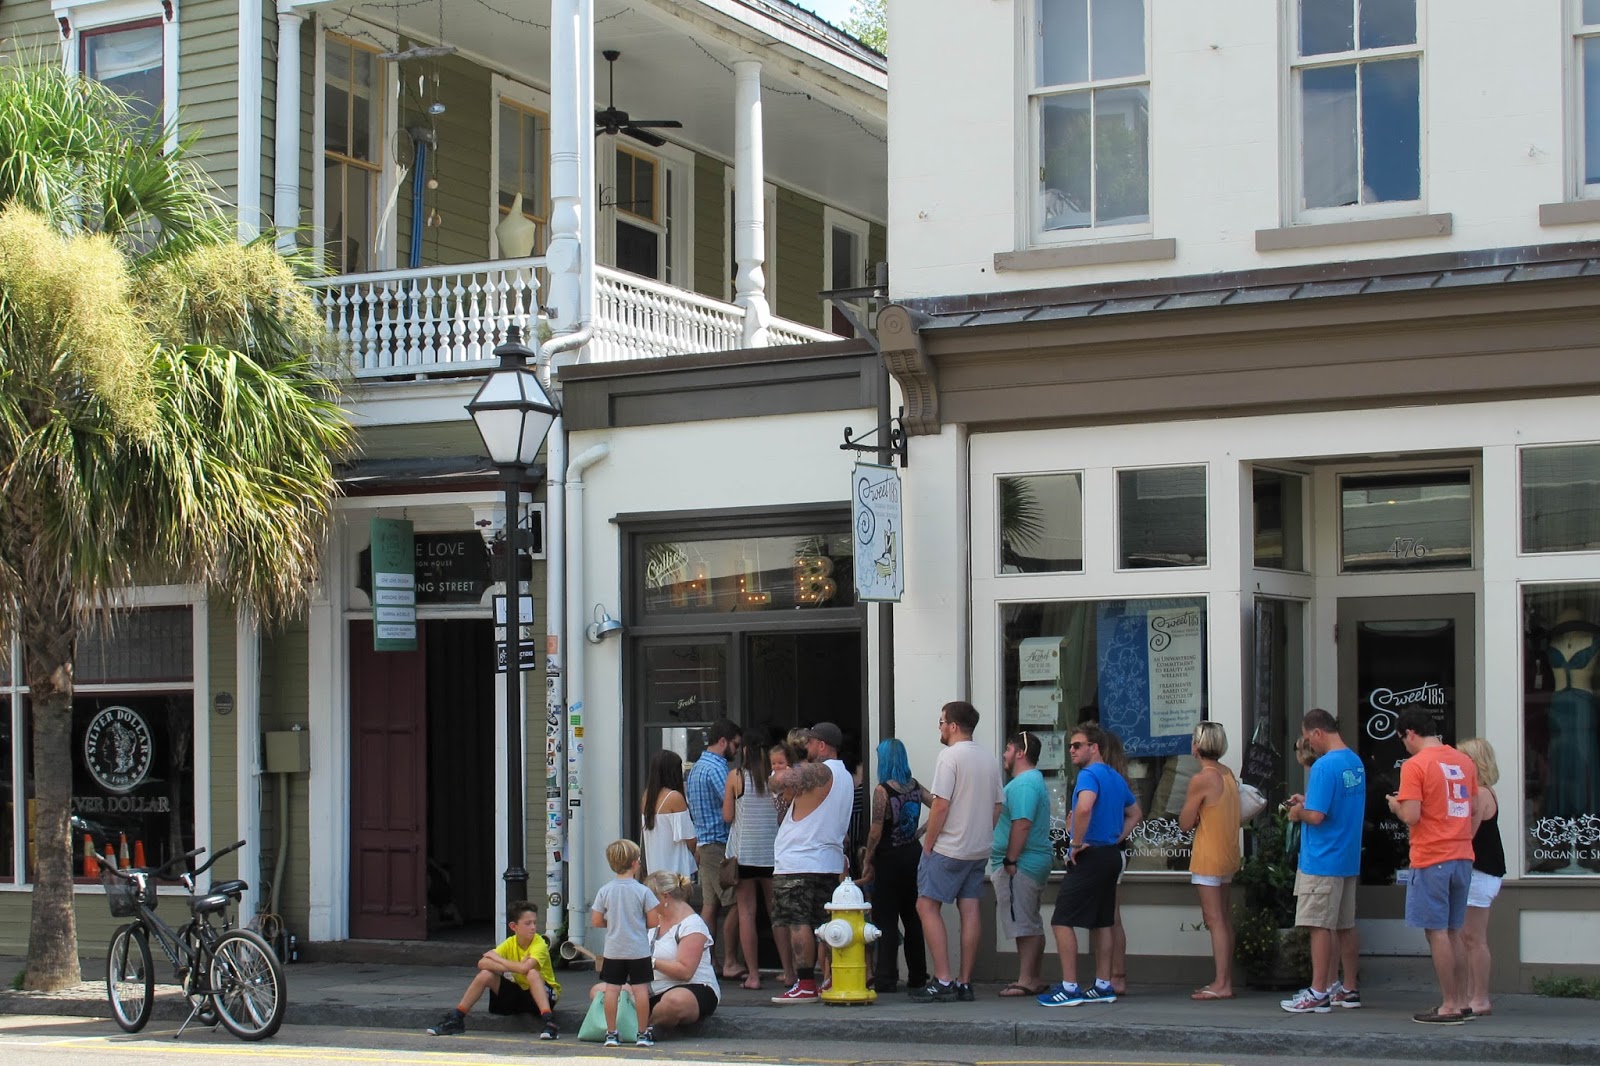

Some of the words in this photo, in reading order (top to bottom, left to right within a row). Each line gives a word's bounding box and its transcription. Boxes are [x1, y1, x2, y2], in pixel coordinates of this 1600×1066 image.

[857, 474, 895, 545] Sweet
[428, 542, 465, 556] LOVE
[1388, 536, 1425, 559] 476
[438, 581, 475, 592] STREET
[1150, 611, 1194, 652] Sweet
[1366, 682, 1439, 740] Sweet
[1428, 688, 1445, 705] 185
[88, 711, 114, 754] SILVER
[117, 710, 148, 754] DOLLAR
[71, 797, 105, 812] VER
[107, 797, 170, 812] DOLLAR
[1534, 849, 1588, 859] ORGANIC
